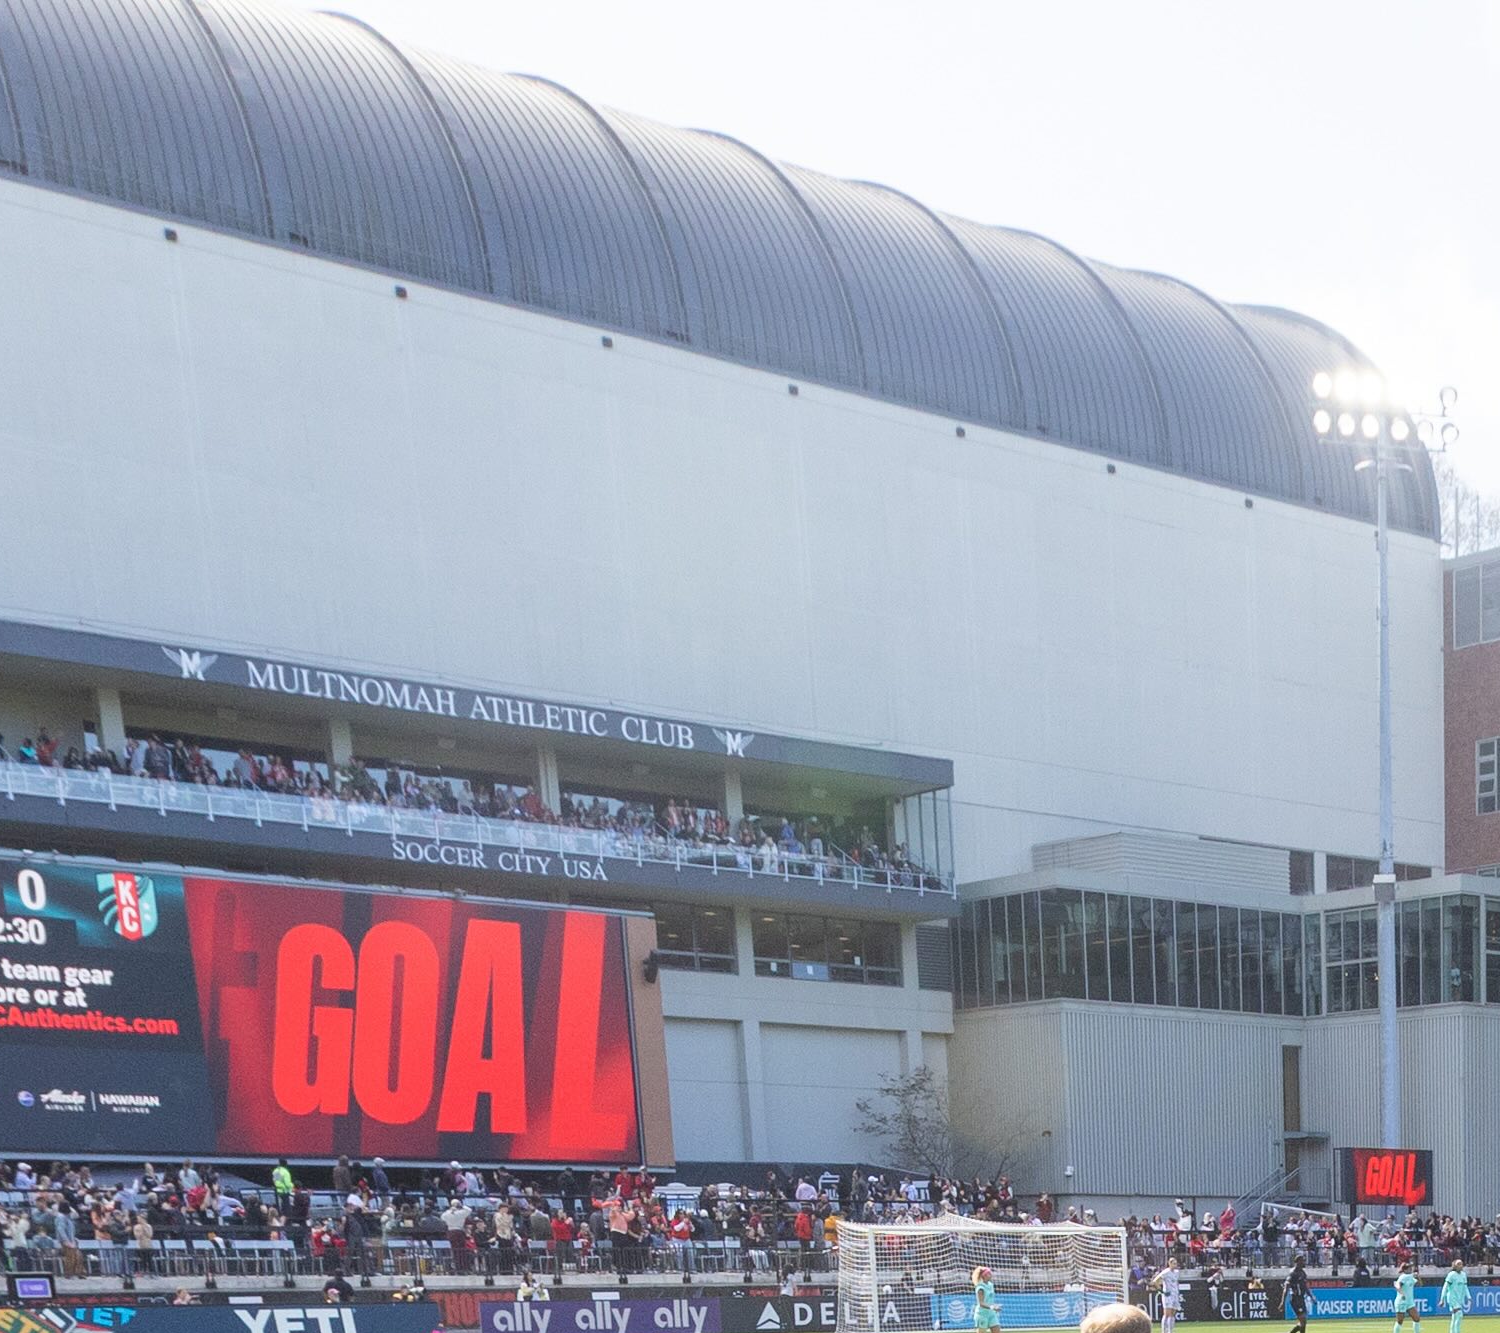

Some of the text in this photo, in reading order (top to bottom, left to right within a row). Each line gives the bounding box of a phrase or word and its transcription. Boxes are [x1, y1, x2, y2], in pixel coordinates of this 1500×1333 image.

[246, 660, 695, 749] MULTNOMAH ATHLETIC CLUB
[392, 840, 609, 881] SOCCER CITY USA
[18, 869, 47, 911] 0
[1, 957, 60, 980] team
[64, 967, 114, 988] gear
[35, 988, 58, 1006] or
[62, 988, 88, 1008] at
[272, 911, 629, 1151] GOAL
[1365, 1153, 1424, 1204] GOAL
[1249, 1292, 1269, 1301] EYES.
[1249, 1301, 1267, 1310] LIPS.
[1317, 1301, 1354, 1315] KAISER
[1249, 1310, 1269, 1319] FACE.
